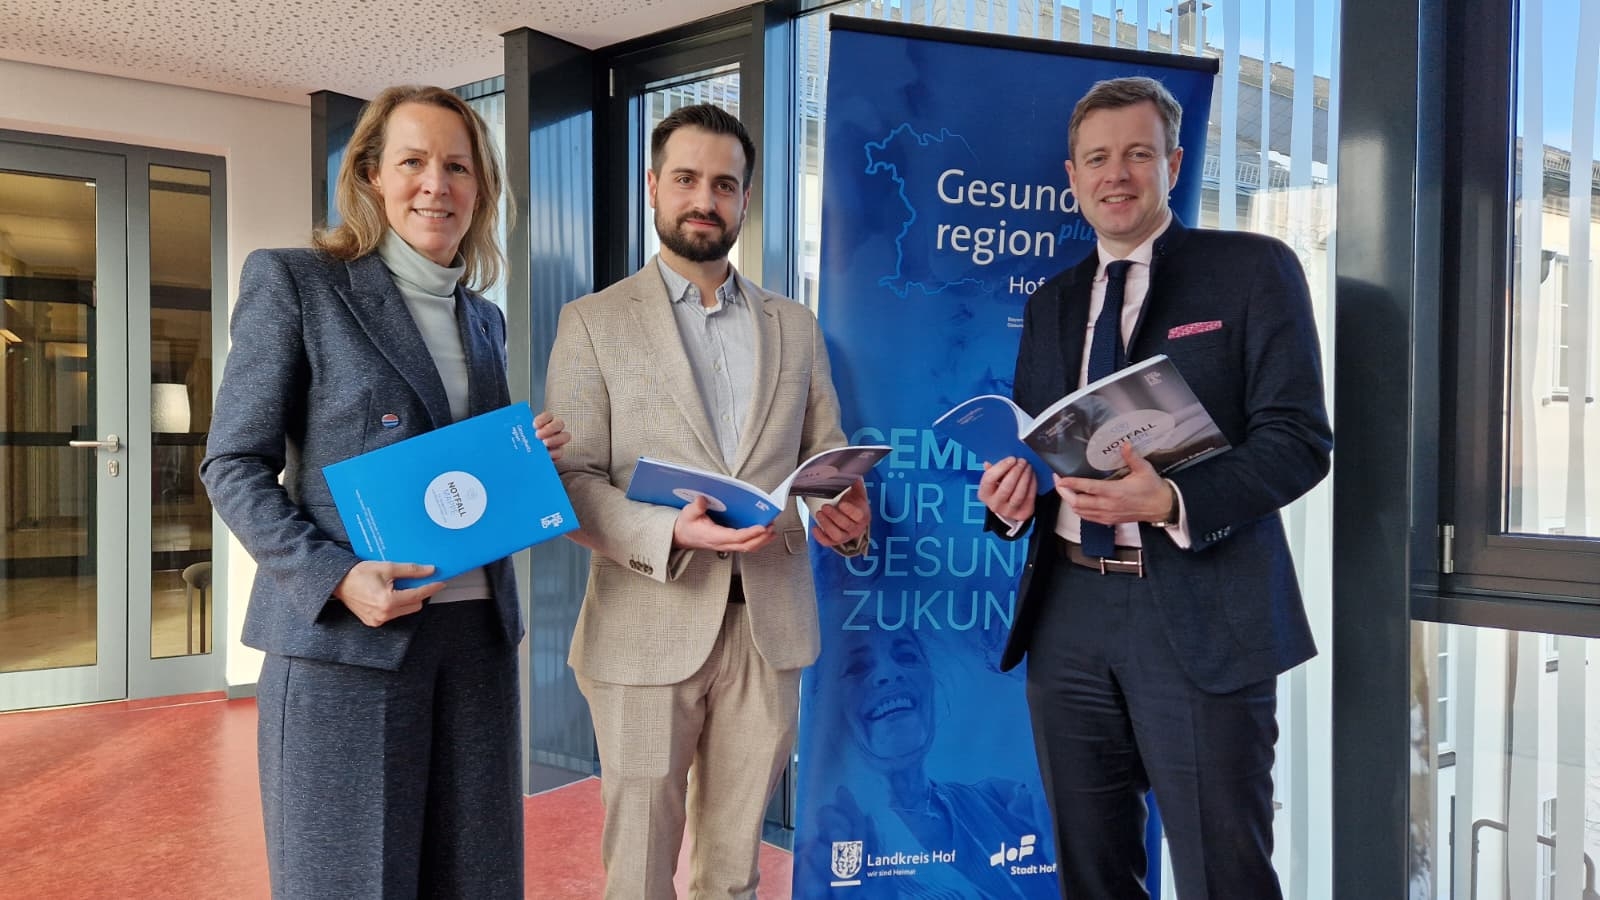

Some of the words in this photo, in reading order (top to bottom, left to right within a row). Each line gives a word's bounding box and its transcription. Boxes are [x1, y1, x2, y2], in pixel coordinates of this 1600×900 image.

[936, 220, 1055, 265] region
[1058, 222, 1098, 245] plu
[1102, 423, 1157, 455] NOTFALL
[447, 480, 467, 518] NOTFALL
[867, 851, 930, 867] Landkreis
[933, 849, 956, 864] Hof
[1010, 864, 1037, 875] Stadt
[1039, 863, 1057, 873] Hof
